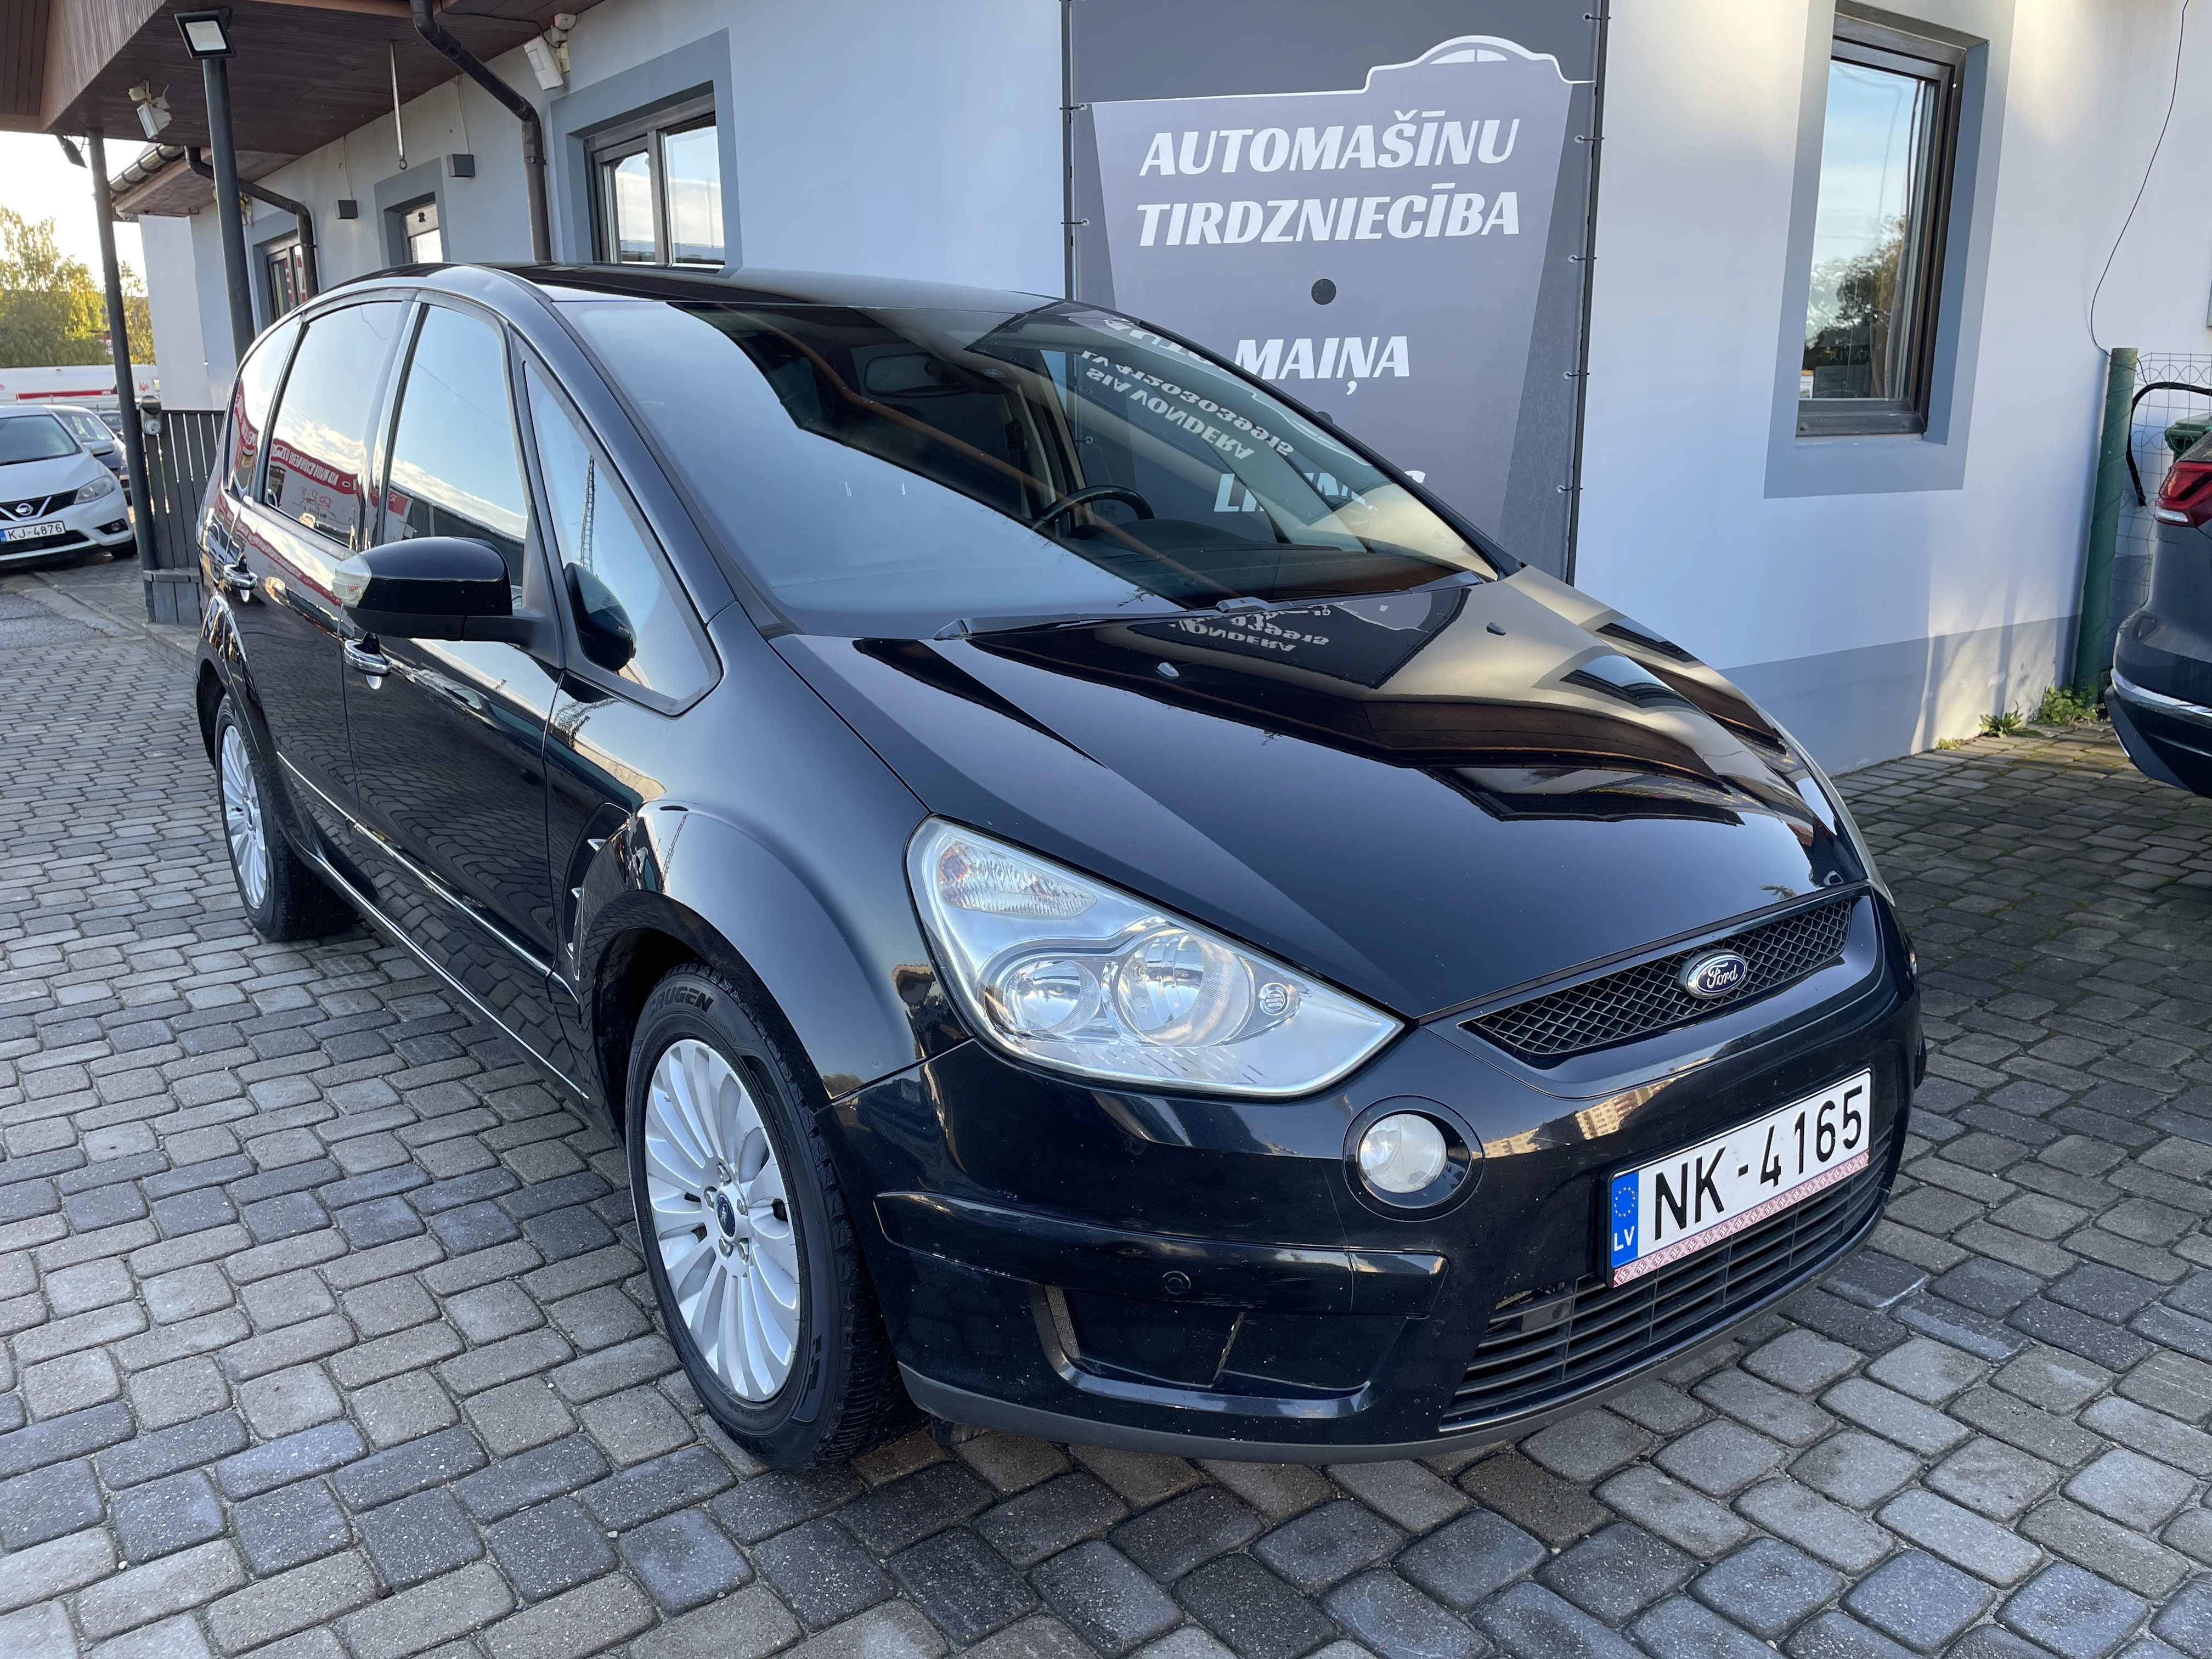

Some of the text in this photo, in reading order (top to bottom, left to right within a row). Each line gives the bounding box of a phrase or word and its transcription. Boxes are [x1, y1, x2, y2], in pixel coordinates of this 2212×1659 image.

[1139, 110, 1520, 177] AUTOMAŠĪNU
[1136, 183, 1520, 246] TIRDZNIECĪBA
[1234, 335, 1410, 396] MAIŅA
[8, 523, 63, 540] KJ-4876
[1706, 962, 1739, 989] Ford
[648, 986, 714, 1019] CRUGEN
[1654, 1084, 1864, 1241] NK-4165
[1613, 1225, 1635, 1252] LV
